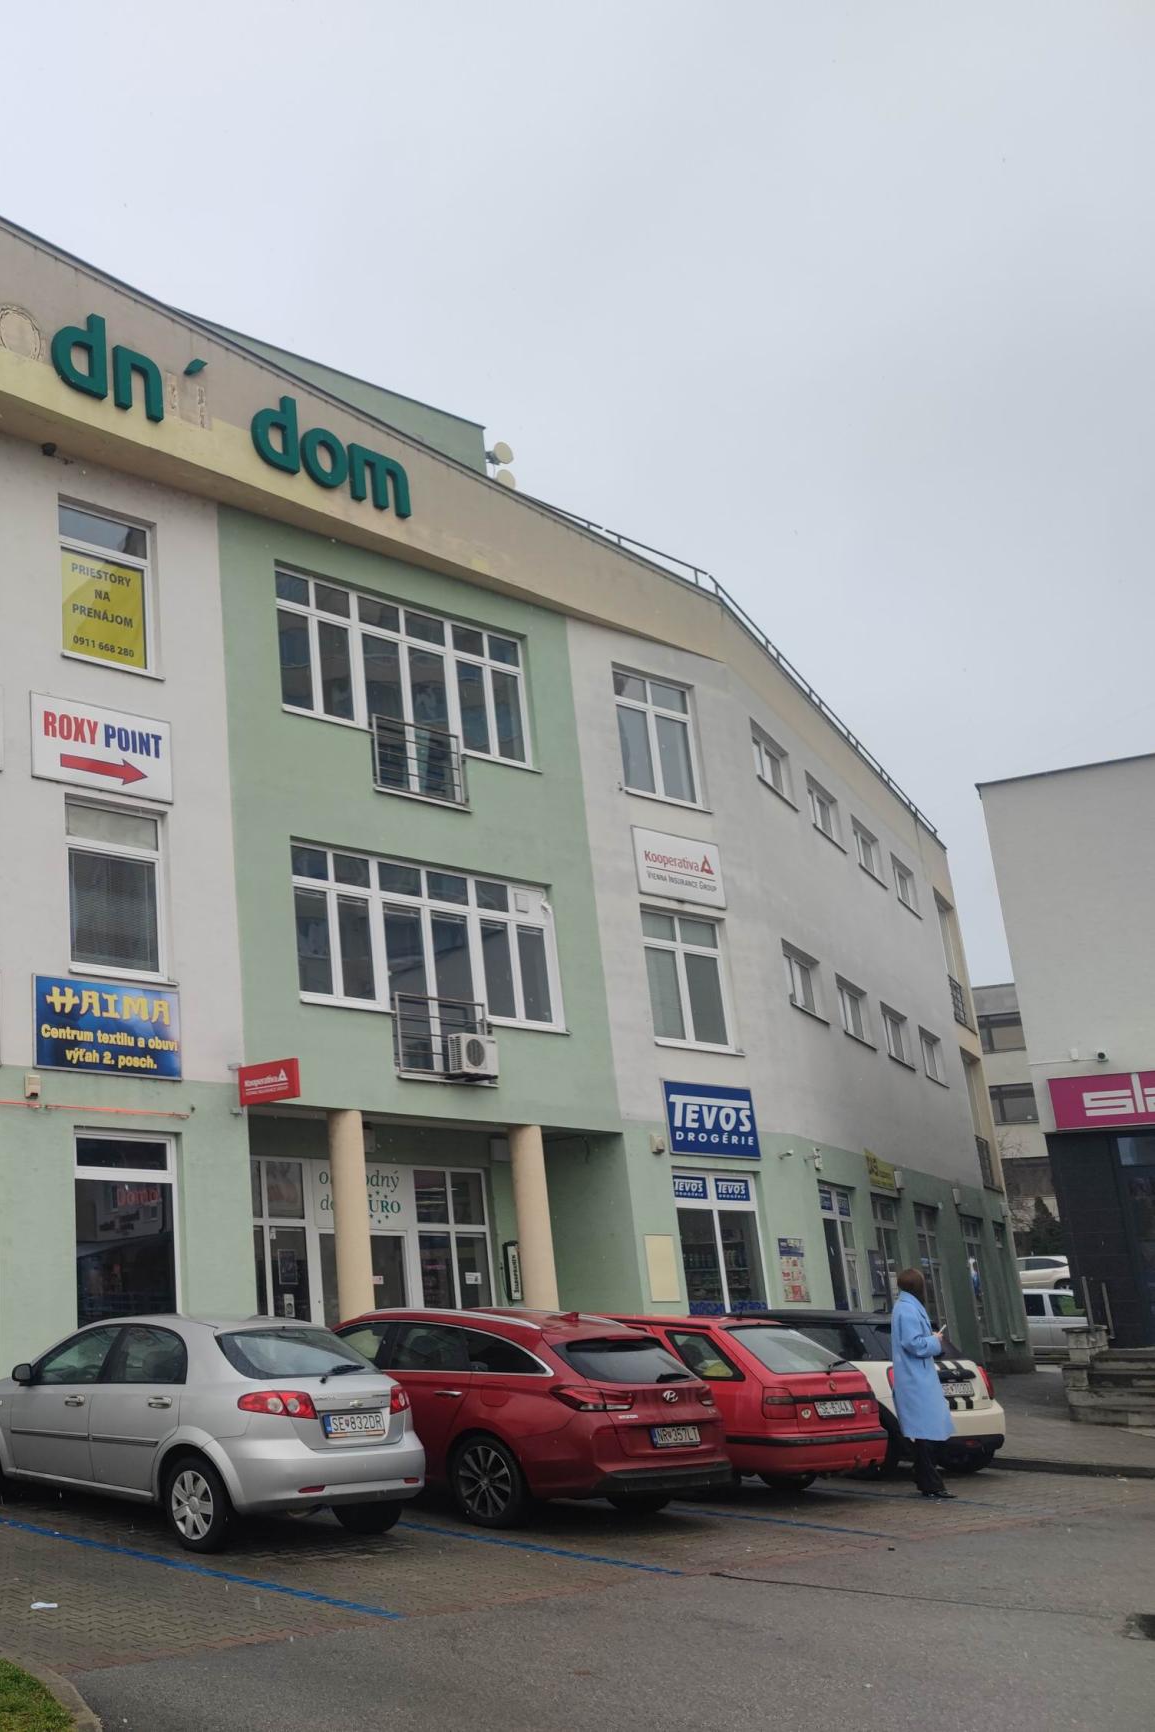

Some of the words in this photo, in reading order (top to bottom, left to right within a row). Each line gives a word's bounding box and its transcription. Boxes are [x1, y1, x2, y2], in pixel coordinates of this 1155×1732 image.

[251, 395, 412, 519] dom
[71, 563, 131, 587] PRIESTORY
[95, 589, 110, 602] NA
[72, 603, 133, 628] PRENÁJOM
[73, 635, 96, 648] 0911
[98, 641, 116, 653] 668
[117, 646, 134, 658] 280
[43, 710, 98, 745] ROXY
[104, 724, 162, 759] POINT
[644, 850, 699, 872] Kooperativa
[46, 986, 170, 1025] HAIMA
[41, 1023, 93, 1042] Centrum
[97, 1030, 134, 1047] textilu
[137, 1038, 145, 1047] a
[118, 1054, 157, 1069] posch.
[669, 1094, 752, 1132] TEVOS
[675, 1131, 754, 1145] DROGÉRIE
[674, 1179, 703, 1192] TEVOS
[717, 1181, 746, 1194] TEVOS
[369, 1200, 401, 1214] URO
